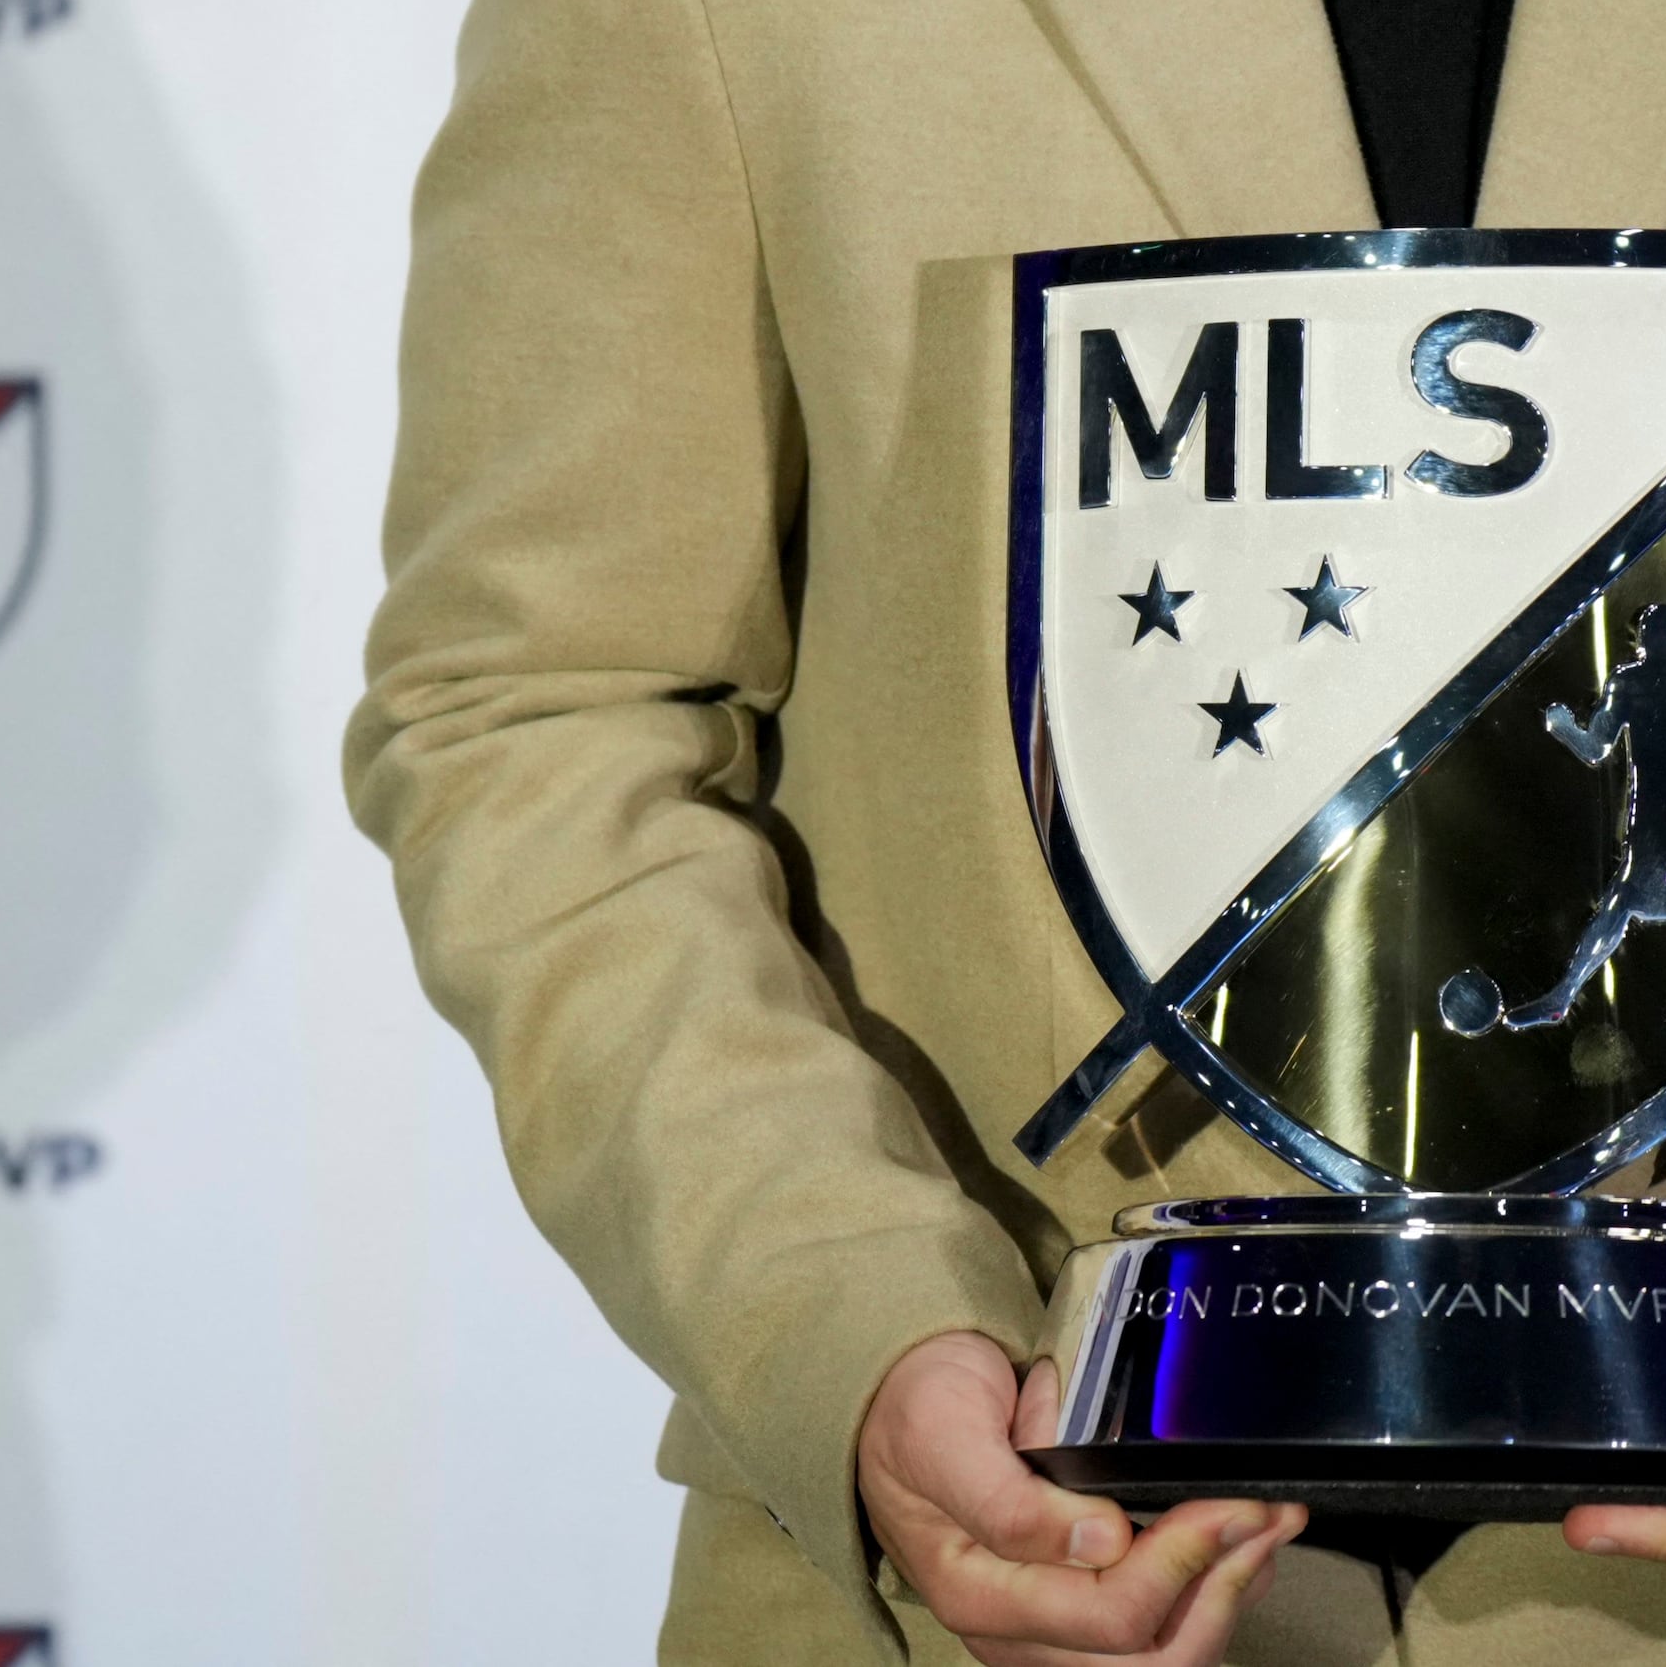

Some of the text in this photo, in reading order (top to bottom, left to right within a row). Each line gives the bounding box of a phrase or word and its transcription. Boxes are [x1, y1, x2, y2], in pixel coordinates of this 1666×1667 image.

[1079, 307, 1549, 510] MLS
[1064, 1286, 1212, 1324] ANDON
[1232, 1280, 1530, 1319] DONOVAN
